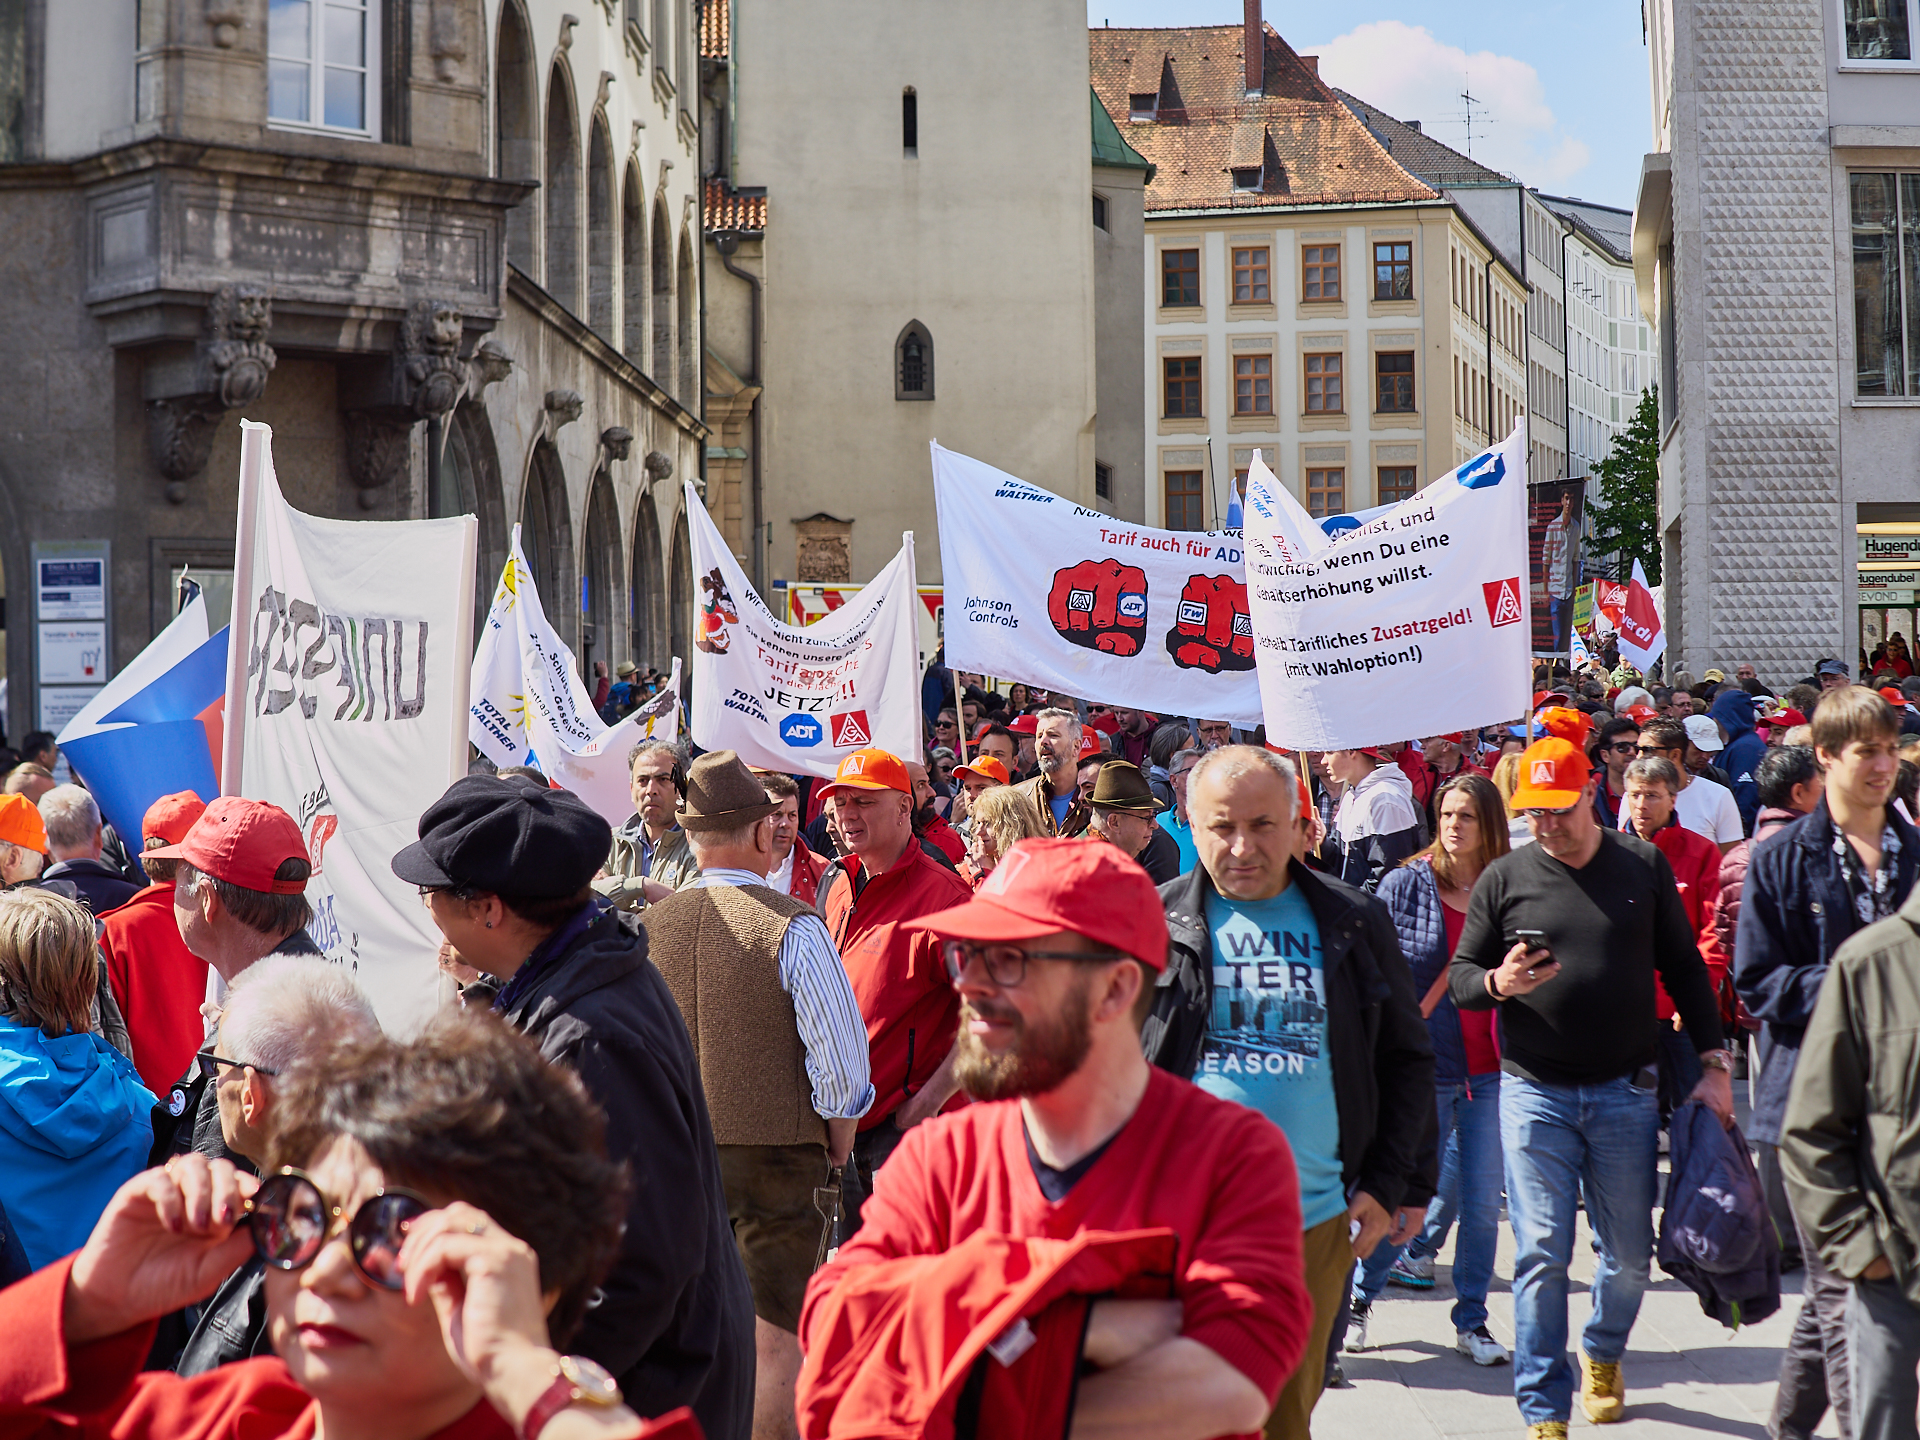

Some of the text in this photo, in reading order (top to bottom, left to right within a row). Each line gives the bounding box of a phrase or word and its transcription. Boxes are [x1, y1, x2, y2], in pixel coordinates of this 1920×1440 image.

[994, 489, 1055, 503] WALTHER
[1400, 506, 1435, 528] und
[1099, 528, 1138, 546] Tarif
[1140, 537, 1180, 553] auch
[1186, 540, 1212, 558] für
[1323, 549, 1375, 571] wenn
[1379, 541, 1406, 560] Du
[1410, 533, 1451, 553] eine
[1378, 564, 1433, 591] willst.
[745, 589, 761, 607] Wir
[964, 596, 1012, 613] Johnson
[1123, 601, 1142, 612] ADT
[969, 610, 1019, 629] Controls
[1183, 608, 1203, 618] TW
[773, 630, 803, 644] Nicht
[806, 638, 830, 647] zum
[1289, 630, 1368, 653] Tarifliches
[1371, 607, 1474, 643] Zusatzgeld!
[1622, 614, 1653, 642] ver.di
[745, 624, 843, 662] Sie kennen unsere
[549, 652, 569, 695] Schluss
[1284, 644, 1423, 678] (mit Wahloption!)
[771, 674, 783, 684] an
[786, 680, 803, 690] die
[479, 698, 512, 731] TOTAL
[470, 705, 516, 752] WALTHER
[785, 725, 817, 739] ADT
[1226, 930, 1323, 958] WIN-
[1225, 960, 1314, 989] TER
[1197, 1052, 1304, 1075] EASON
